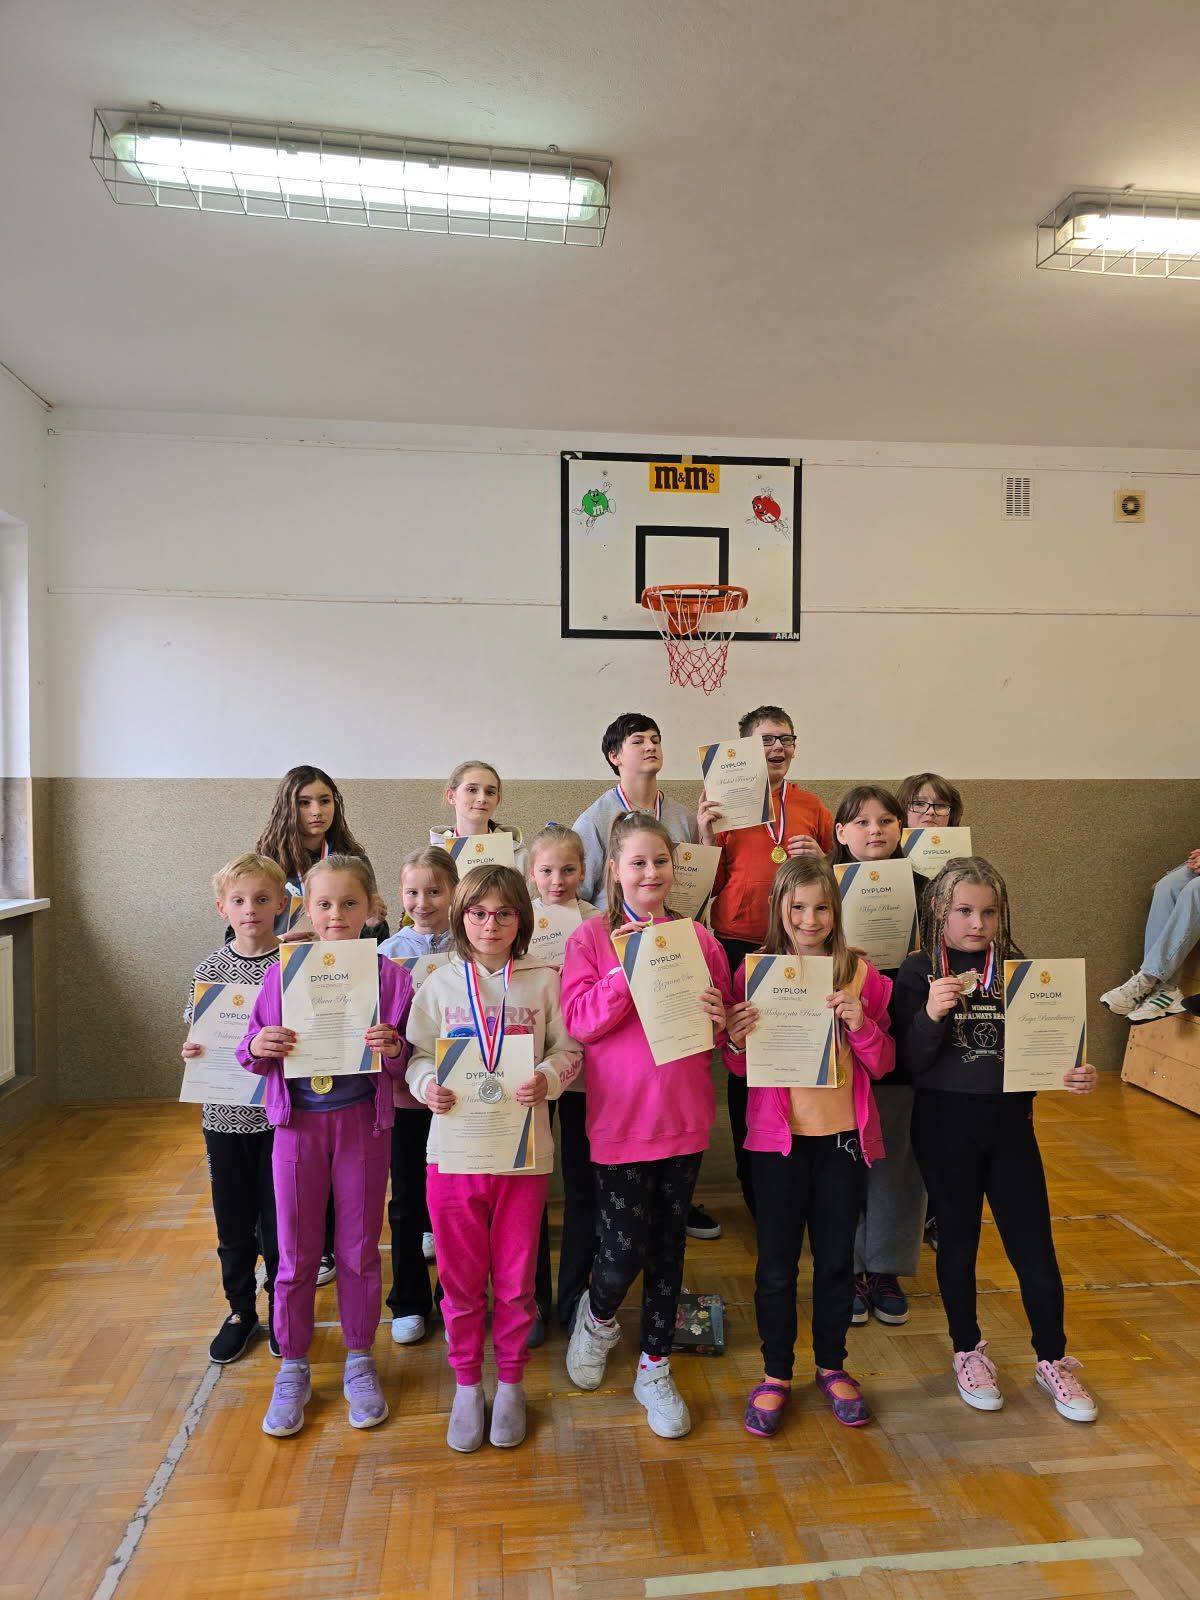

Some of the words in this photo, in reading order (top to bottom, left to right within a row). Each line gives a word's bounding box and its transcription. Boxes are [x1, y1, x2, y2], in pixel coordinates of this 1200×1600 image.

[776, 632, 799, 640] ARAN
[720, 761, 747, 770] DYPLOM
[467, 857, 495, 865] DYPLOM
[861, 887, 892, 895] DYPLOM
[531, 931, 562, 944] DYPLOM
[650, 953, 682, 966] DYPLOM
[310, 973, 349, 982] DYPLOM
[773, 987, 807, 995] DYPLOM
[444, 1005, 540, 1025] HUTRIX
[486, 1086, 493, 1095] 2
